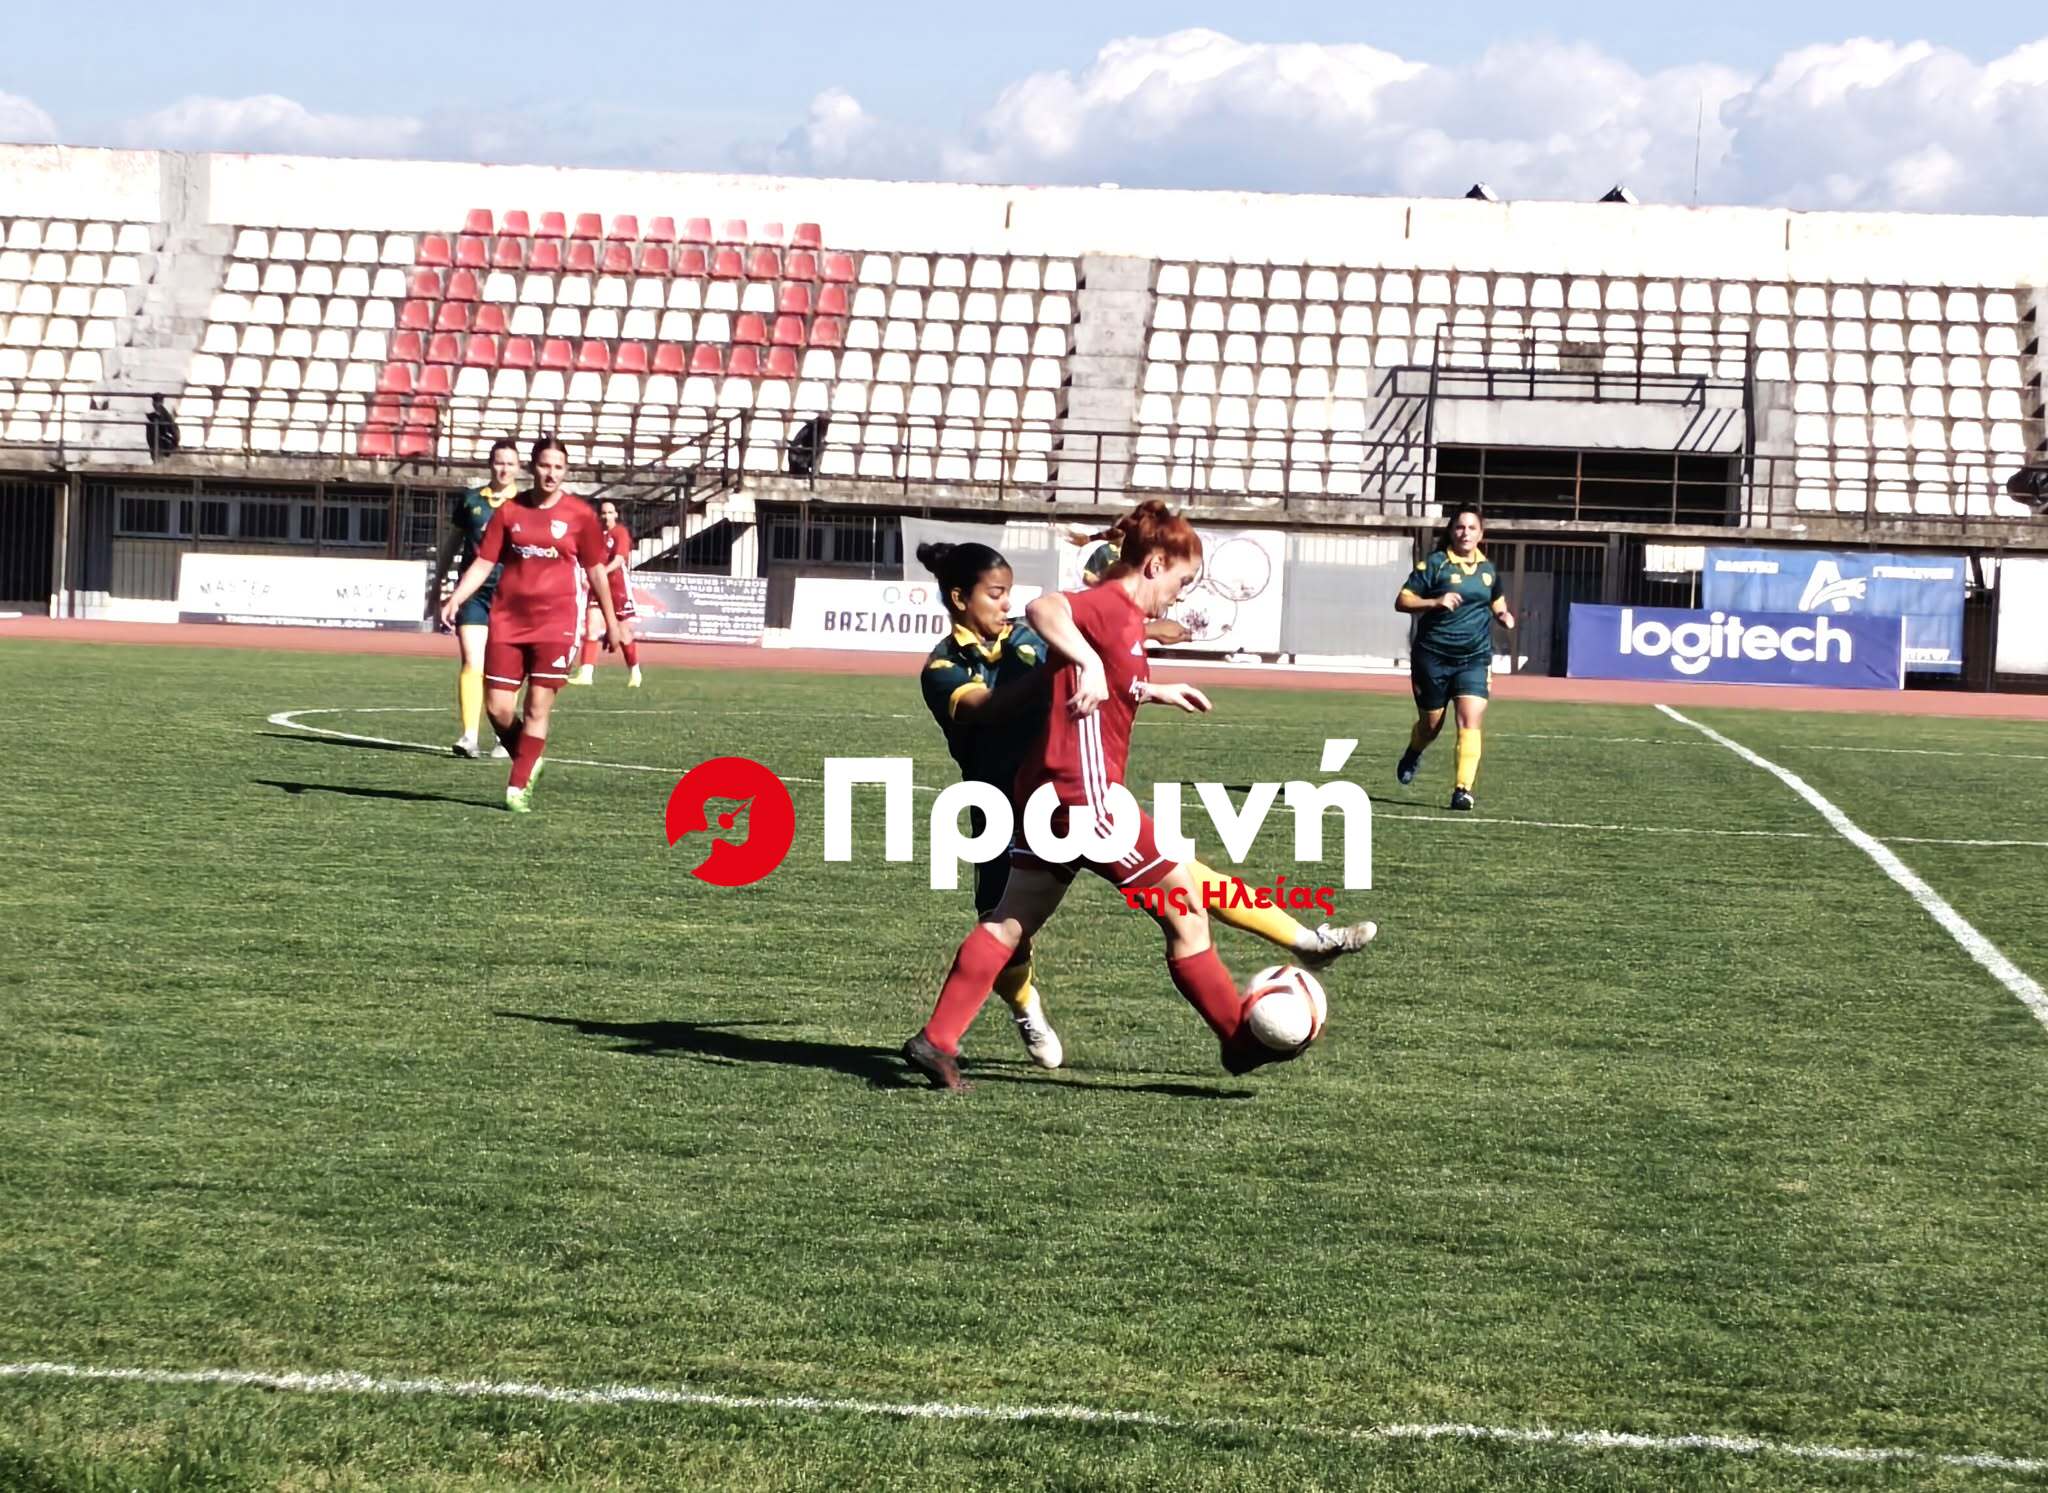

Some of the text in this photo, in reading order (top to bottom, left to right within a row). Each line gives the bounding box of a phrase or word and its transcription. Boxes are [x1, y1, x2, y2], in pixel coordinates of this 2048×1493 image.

[511, 544, 559, 559] gitech
[200, 578, 273, 596] MAER
[631, 575, 662, 583] OSCH
[336, 584, 407, 601] MAER
[824, 611, 949, 634] ΒΑΣΙΛΟΠΟ
[1620, 608, 1852, 675] logitech
